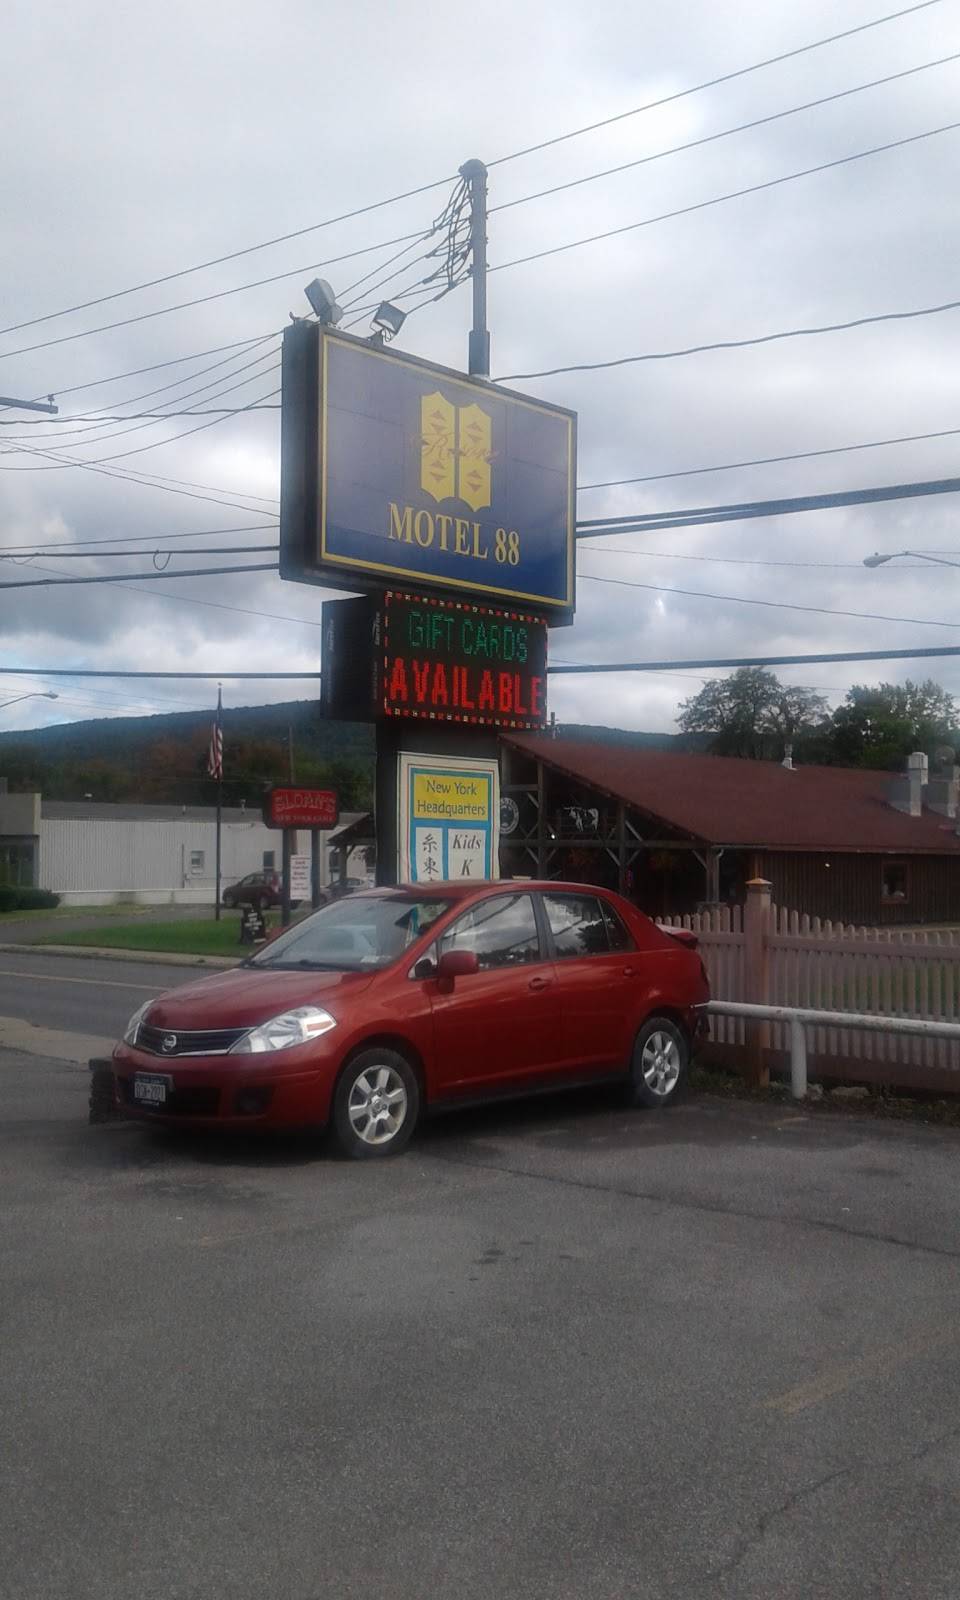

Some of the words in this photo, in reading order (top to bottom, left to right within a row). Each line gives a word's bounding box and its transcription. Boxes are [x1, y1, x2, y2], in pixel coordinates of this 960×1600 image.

[388, 502, 488, 559] MOTEL
[495, 528, 520, 565] 88
[408, 610, 454, 651] GIFT
[462, 618, 528, 663] CARDS
[390, 657, 542, 716] AVAILABLE
[426, 780, 451, 793] New
[455, 782, 477, 796] York
[417, 800, 485, 816] Headquarters
[453, 835, 482, 849] Kids
[461, 859, 472, 876] K
